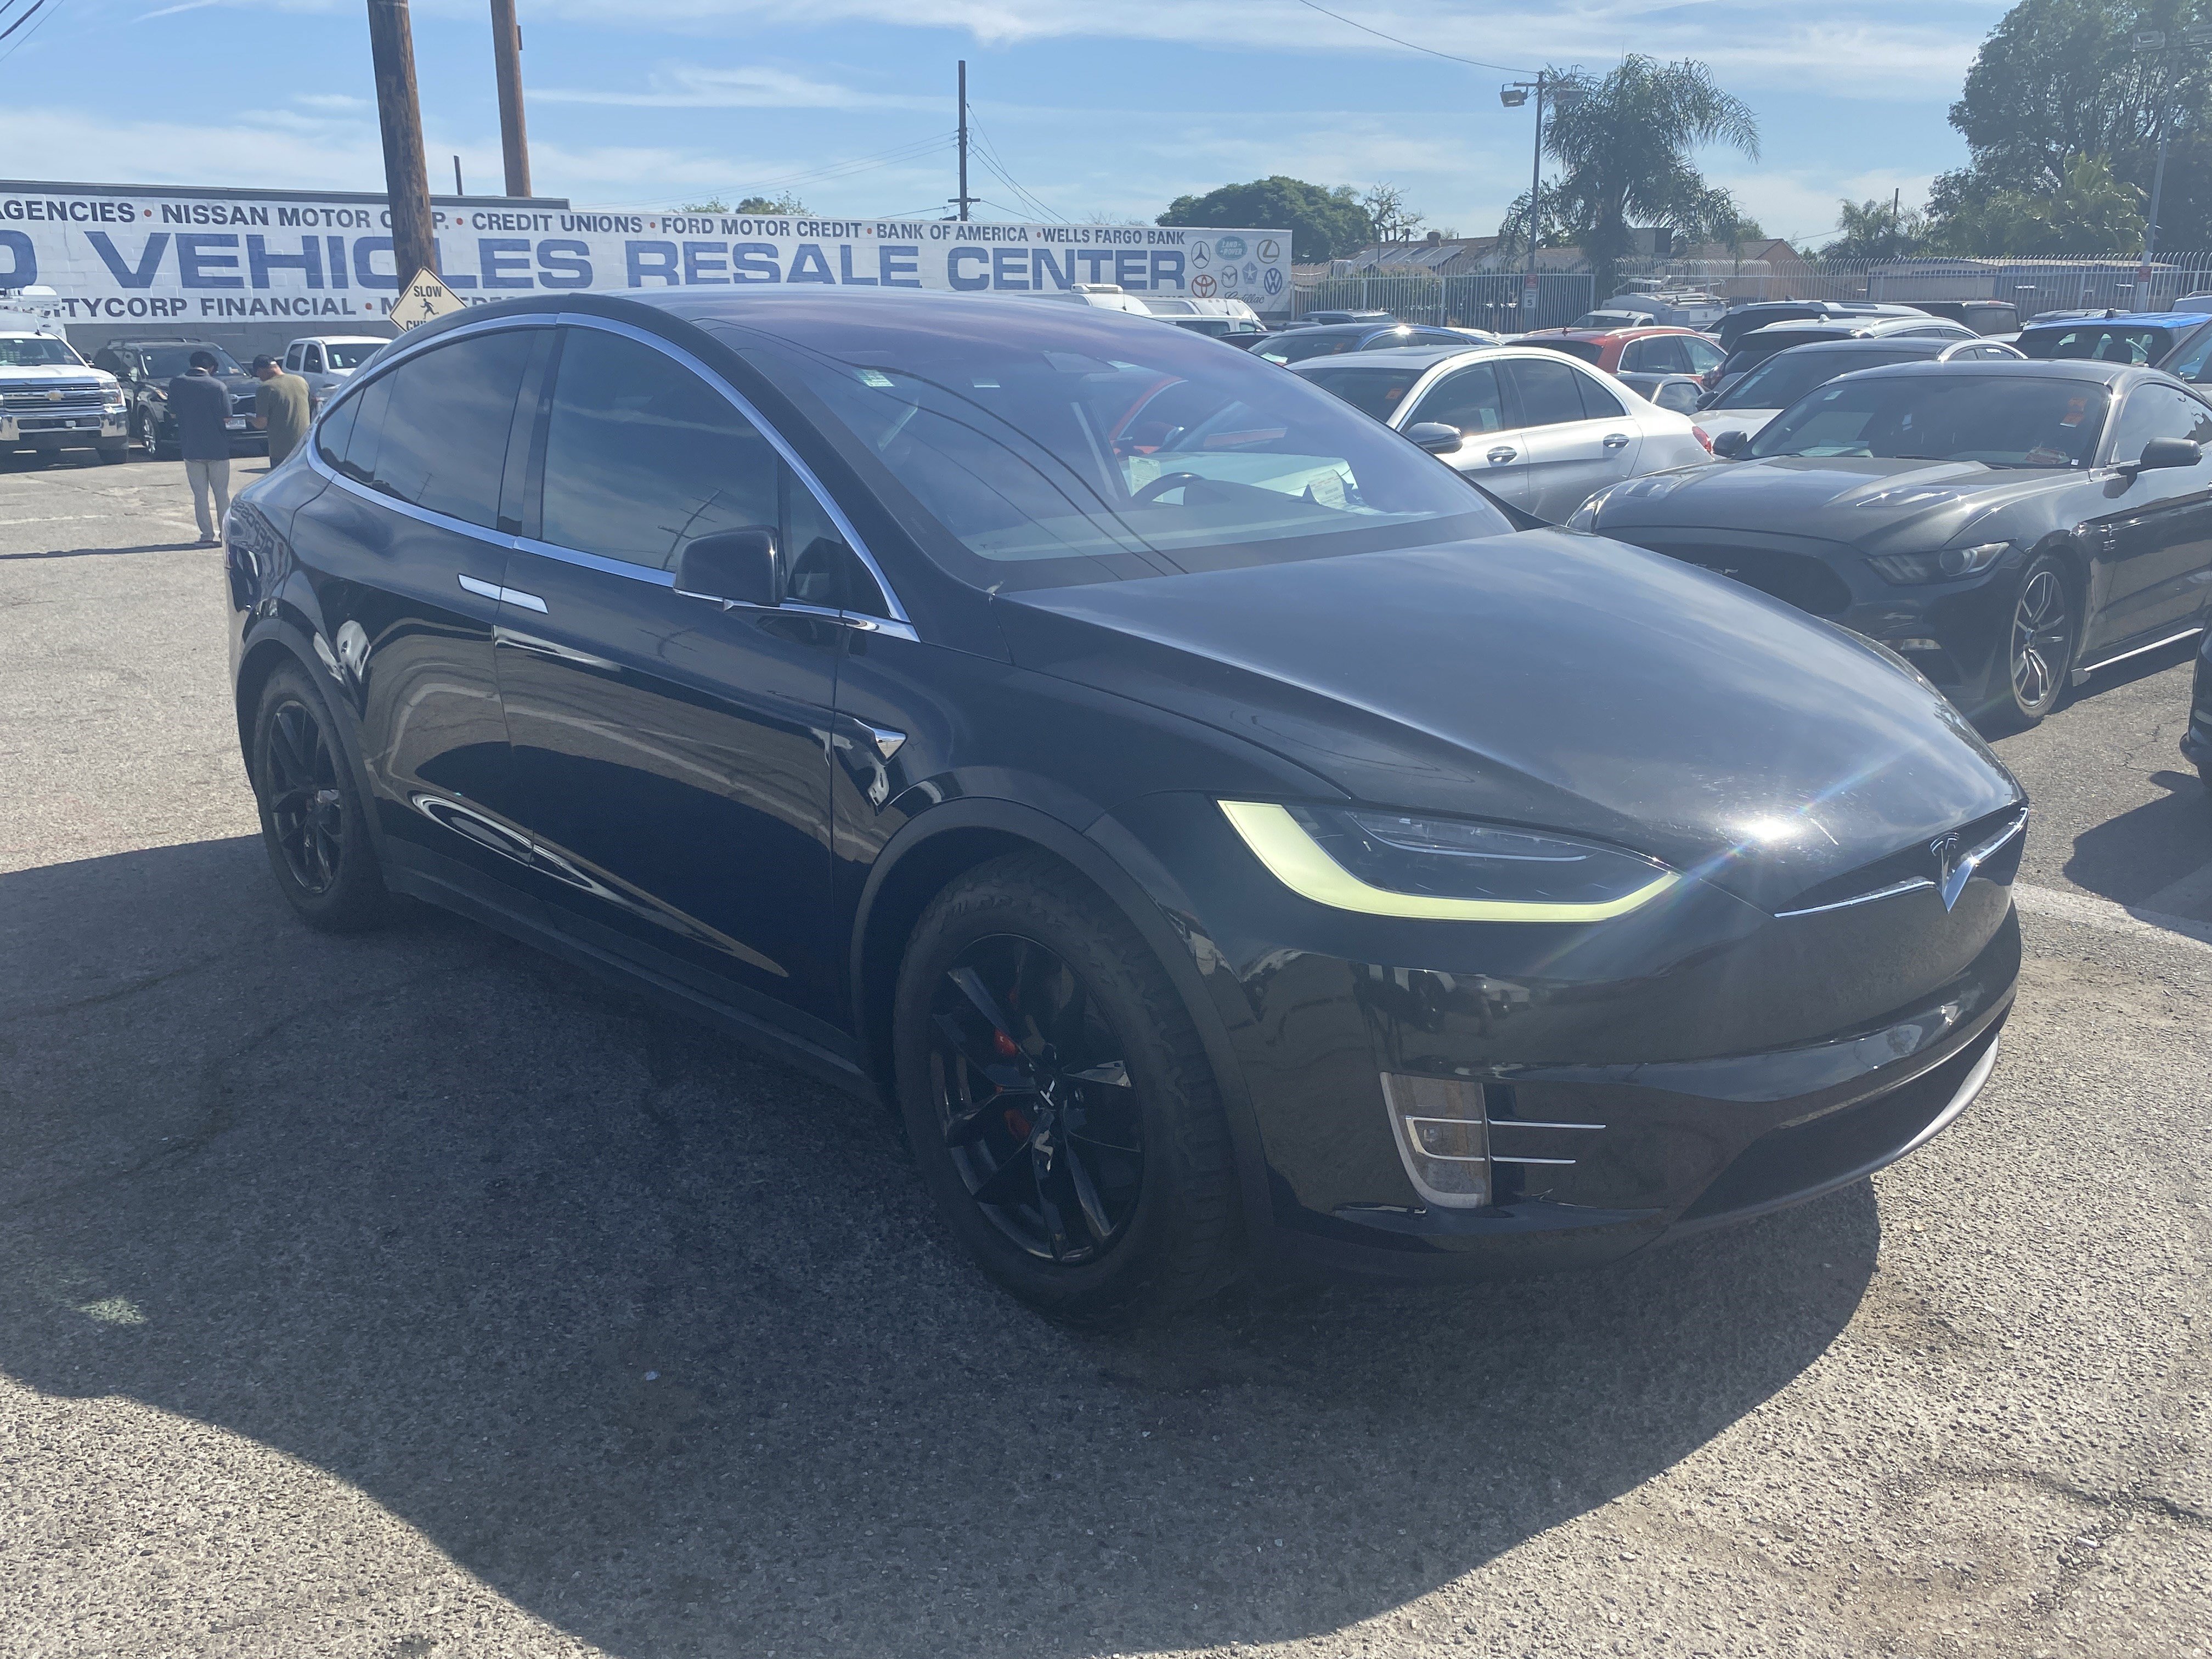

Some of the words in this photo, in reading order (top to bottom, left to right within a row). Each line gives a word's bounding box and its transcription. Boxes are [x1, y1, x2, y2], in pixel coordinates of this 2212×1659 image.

[0, 200, 135, 222] GENCIES
[161, 204, 269, 225] NISSAN
[278, 207, 371, 228] MOTOR
[380, 211, 449, 229] CP.
[472, 213, 552, 231] CREDIT
[561, 215, 642, 233] UNIONS
[662, 217, 714, 234] FORD
[721, 219, 790, 236] MOTOR
[797, 221, 862, 238] CREDIT
[878, 223, 924, 239] BANK
[930, 225, 950, 240] OF
[956, 226, 1028, 241] AMERICA
[1043, 228, 1090, 243] WELLS
[1095, 229, 1142, 244] FARGO
[1147, 231, 1185, 244] BANK
[625, 240, 920, 287] RESALE
[947, 246, 1185, 291] CENTER
[200, 297, 356, 316] FINANCIAL
[414, 285, 442, 297] SLOW
